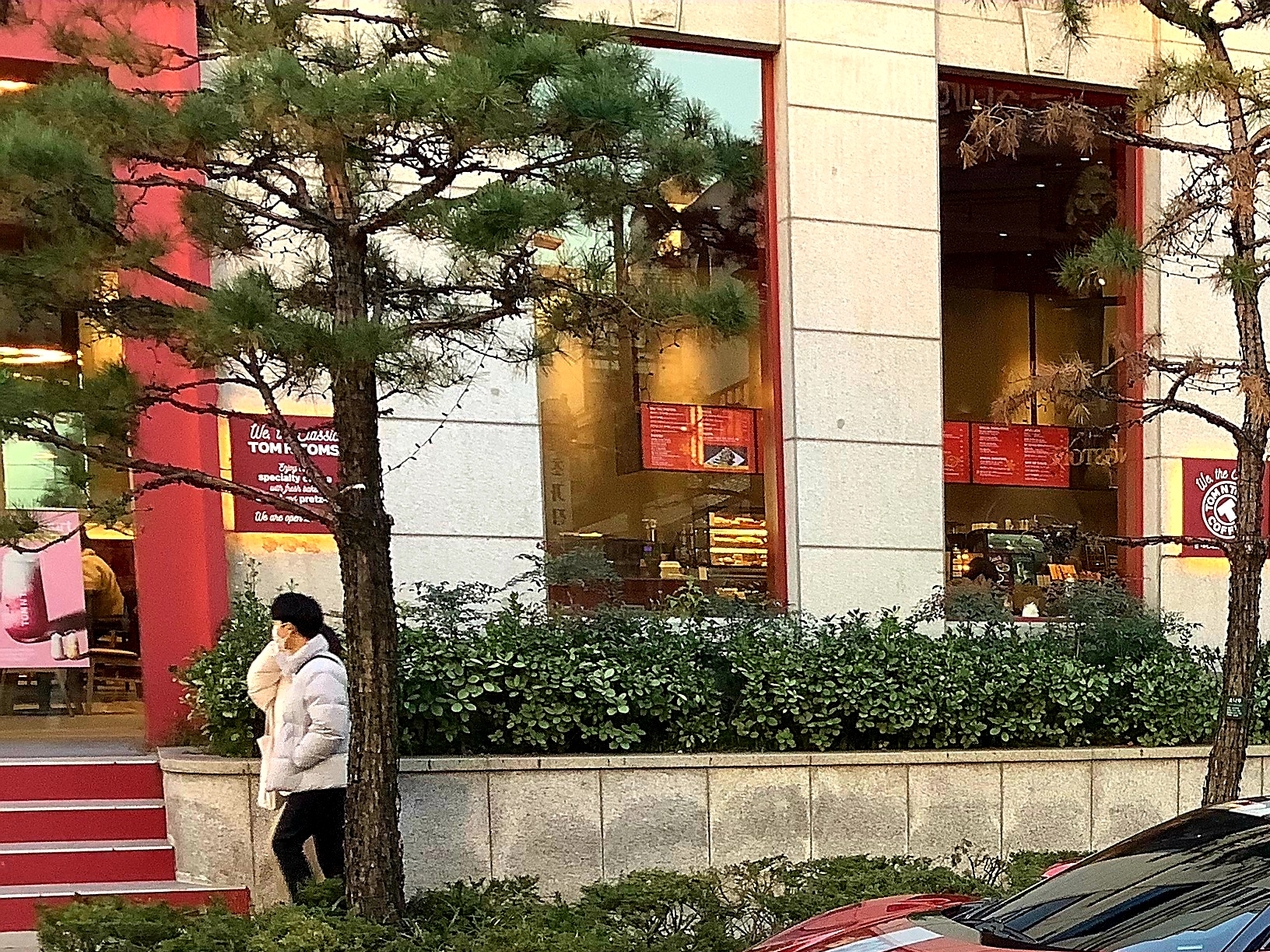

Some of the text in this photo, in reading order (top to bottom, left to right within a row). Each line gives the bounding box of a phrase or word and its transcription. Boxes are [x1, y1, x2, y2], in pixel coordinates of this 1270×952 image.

[248, 442, 281, 454] TOM
[257, 473, 301, 484] specialty
[1215, 468, 1229, 480] the
[255, 511, 303, 524] We are open
